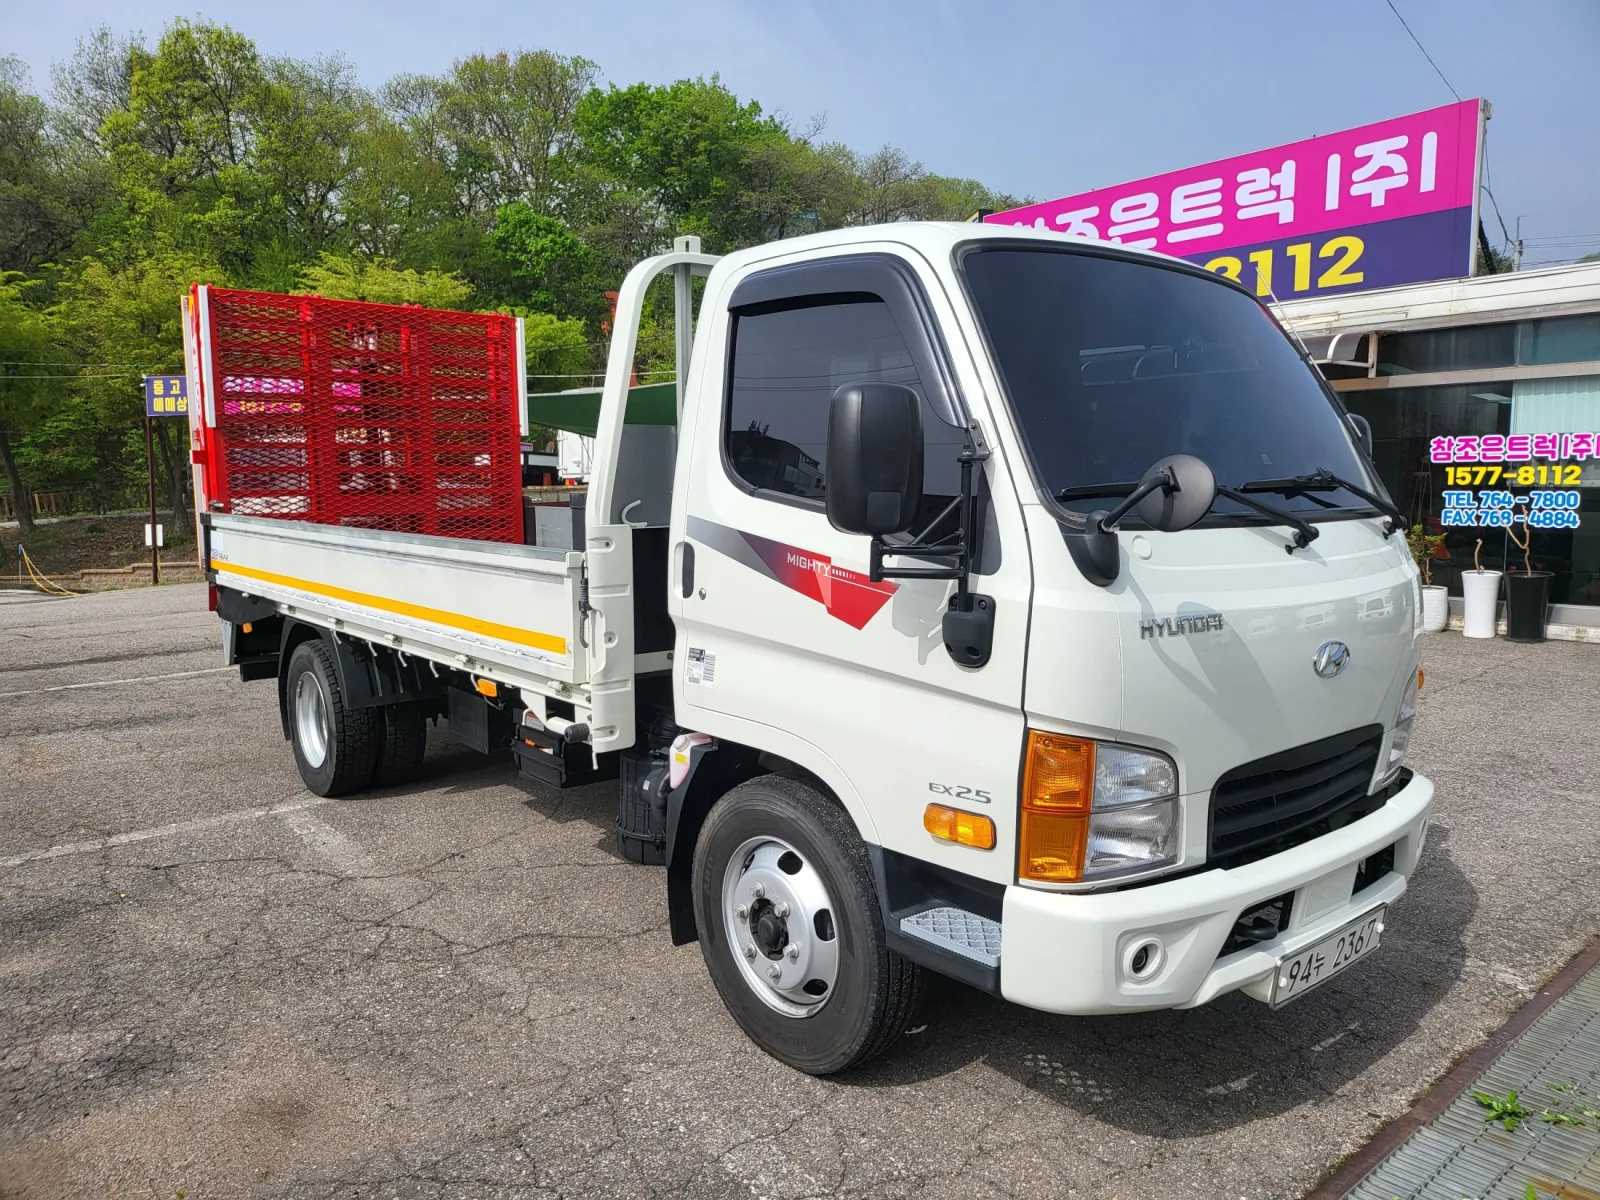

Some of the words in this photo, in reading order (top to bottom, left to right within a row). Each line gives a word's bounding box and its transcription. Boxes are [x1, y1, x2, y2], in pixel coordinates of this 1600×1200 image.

[1445, 465, 1582, 486] 1577-8112
[1443, 491, 1478, 508] TEL
[1442, 509, 1477, 526] FAX
[787, 552, 831, 577] MIGHTY
[1139, 613, 1224, 640] HYUNDAI
[1333, 918, 1377, 969] 2367
